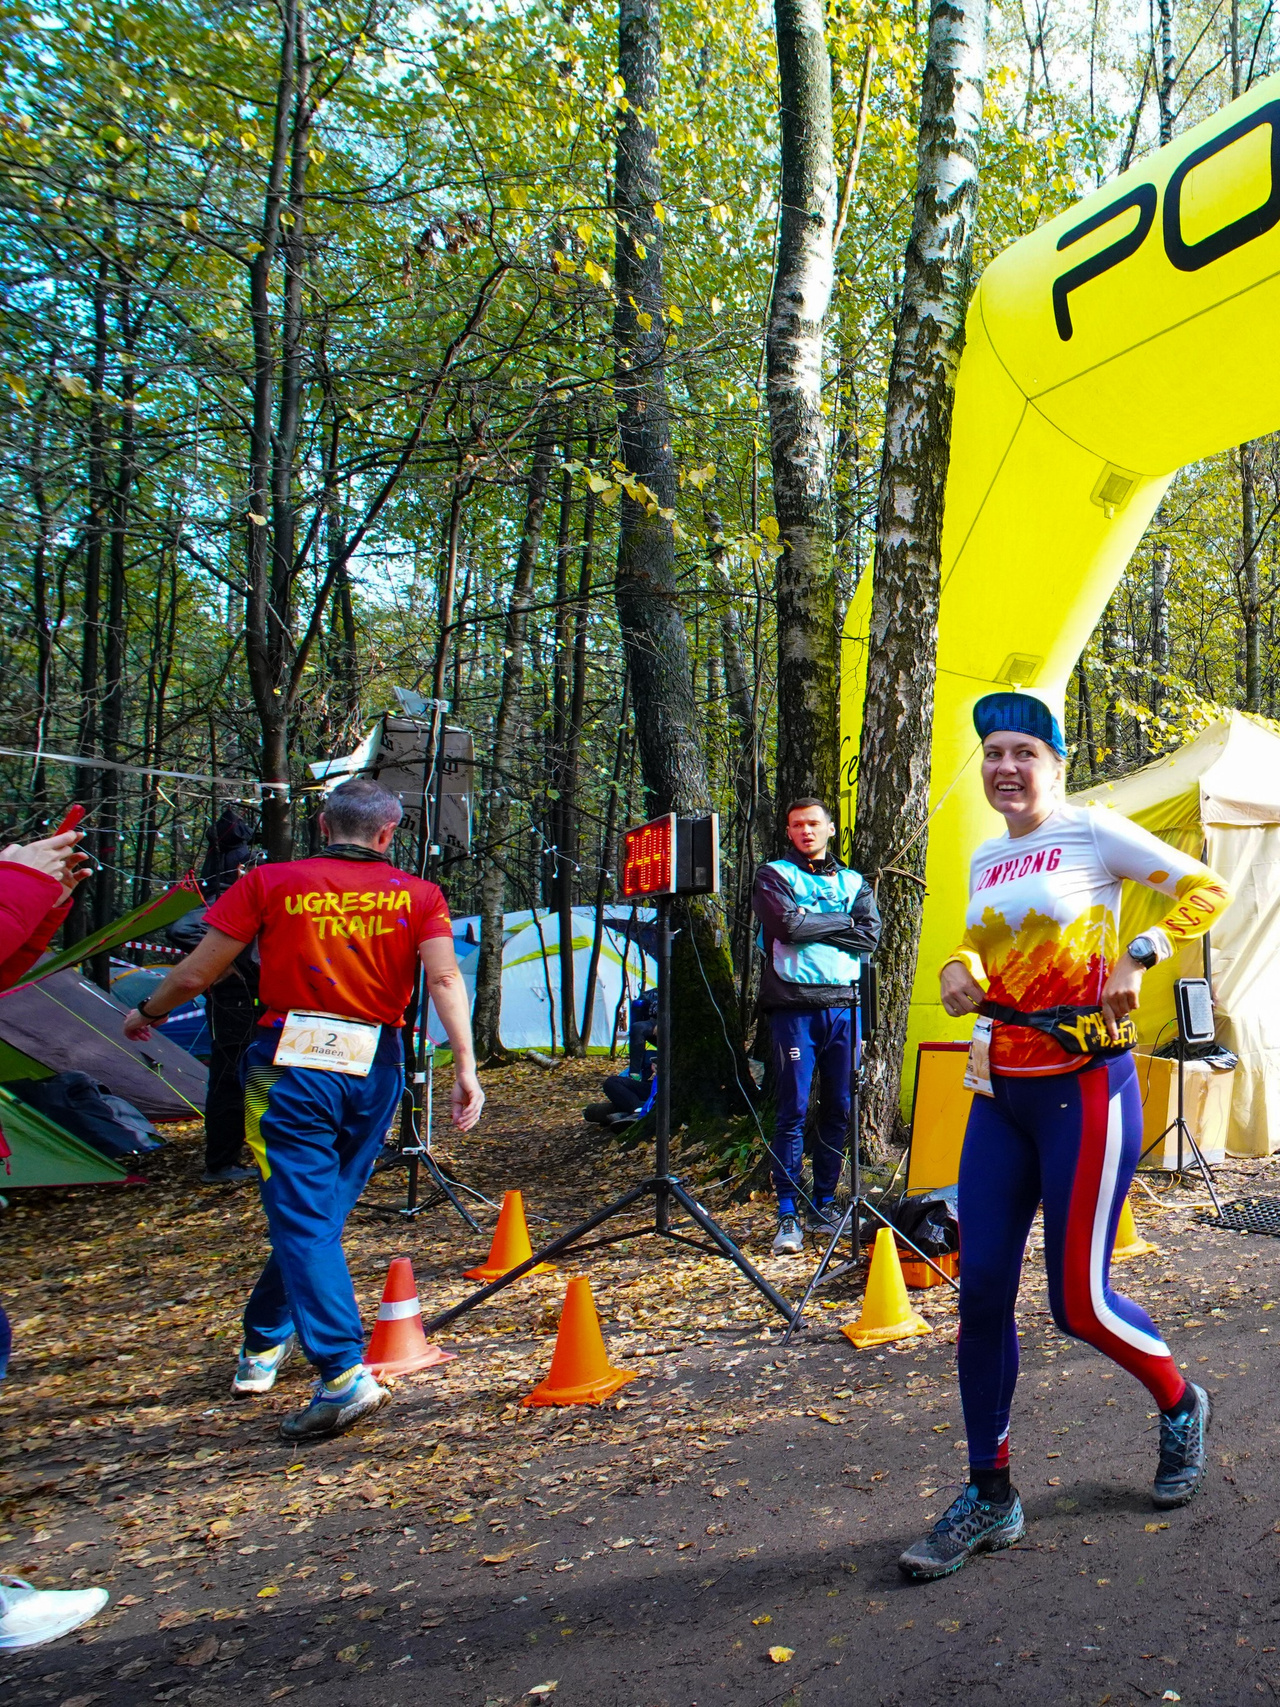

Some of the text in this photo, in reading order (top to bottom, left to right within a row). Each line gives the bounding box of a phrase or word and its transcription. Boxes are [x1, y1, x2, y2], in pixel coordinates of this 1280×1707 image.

[974, 848, 1062, 892] IZMYLONG
[285, 890, 411, 915] UGRESHA
[312, 915, 395, 940] TRAIL
[311, 1045, 344, 1057] Павел
[324, 1032, 338, 1047] 2
